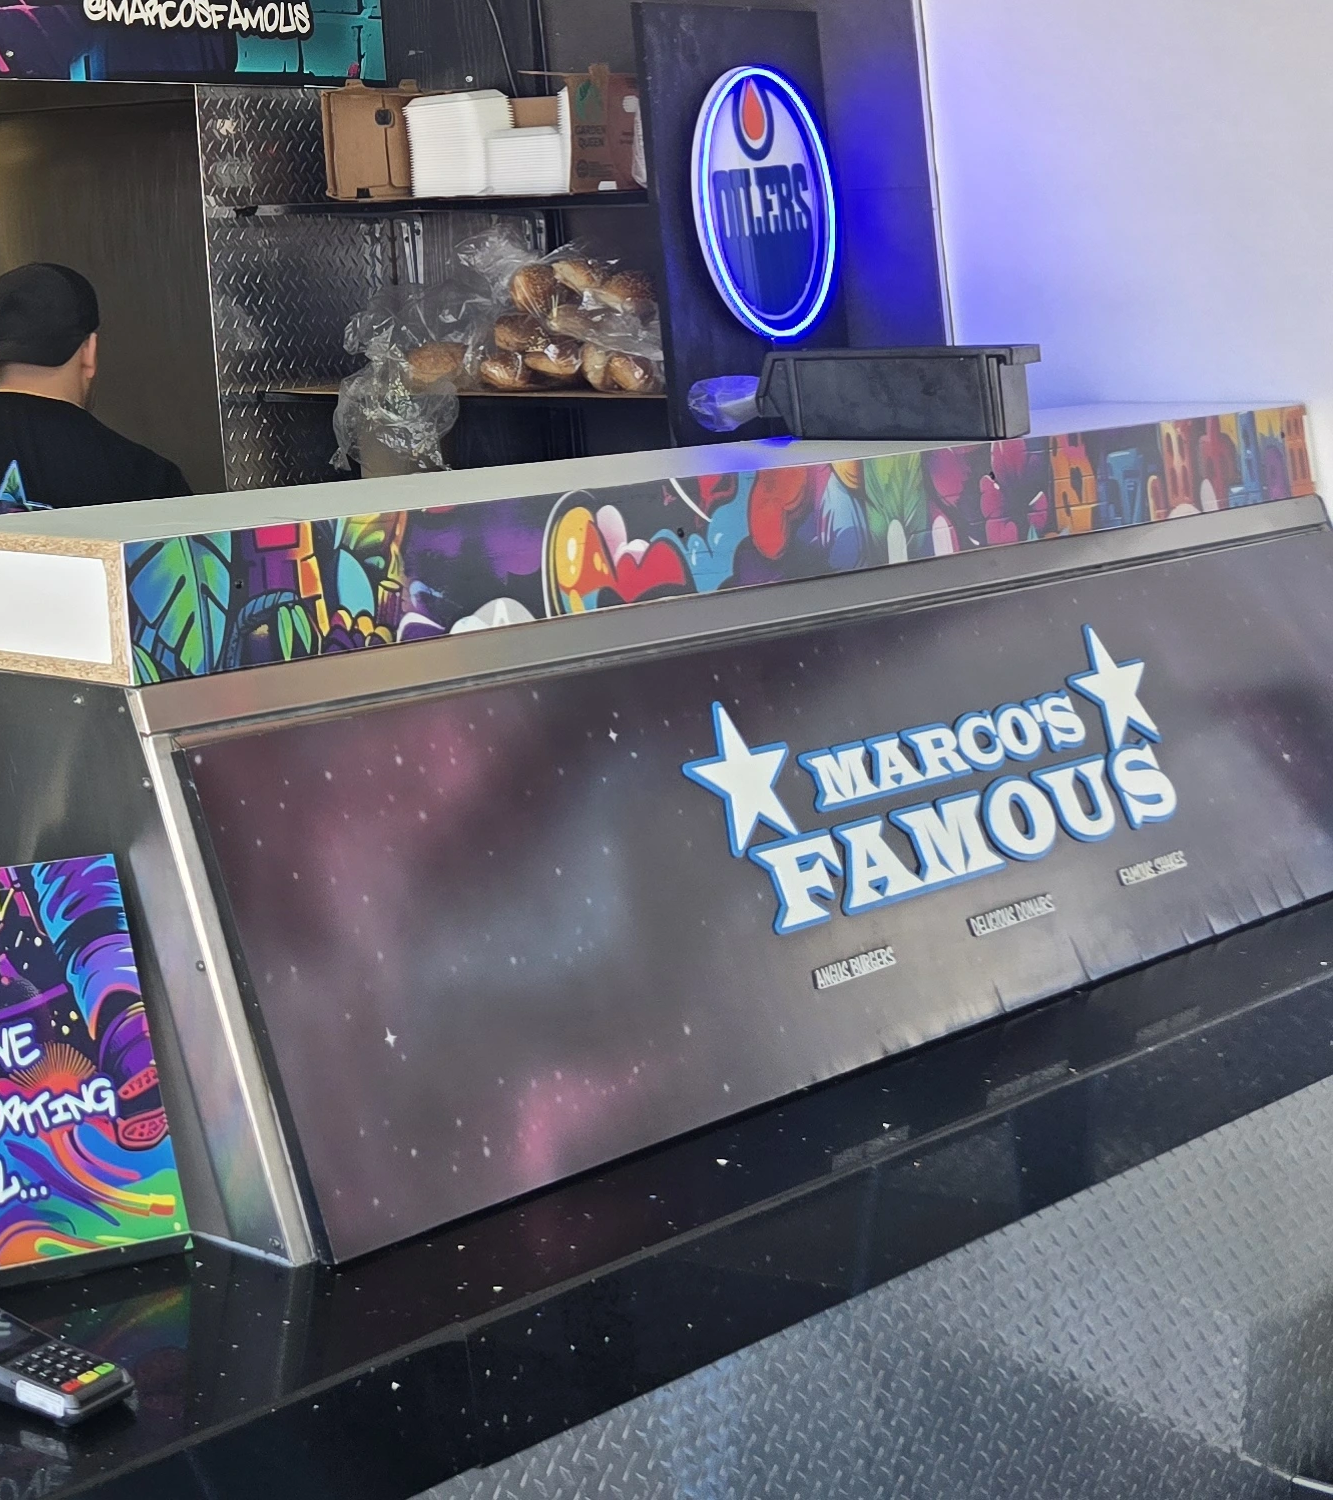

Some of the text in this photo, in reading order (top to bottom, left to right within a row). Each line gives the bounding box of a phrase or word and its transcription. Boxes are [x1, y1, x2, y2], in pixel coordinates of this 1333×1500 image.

[798, 690, 1087, 813] MARCO'S
[748, 742, 1178, 936] FAMOUS
[813, 946, 897, 990] ANGUS BURGERS
